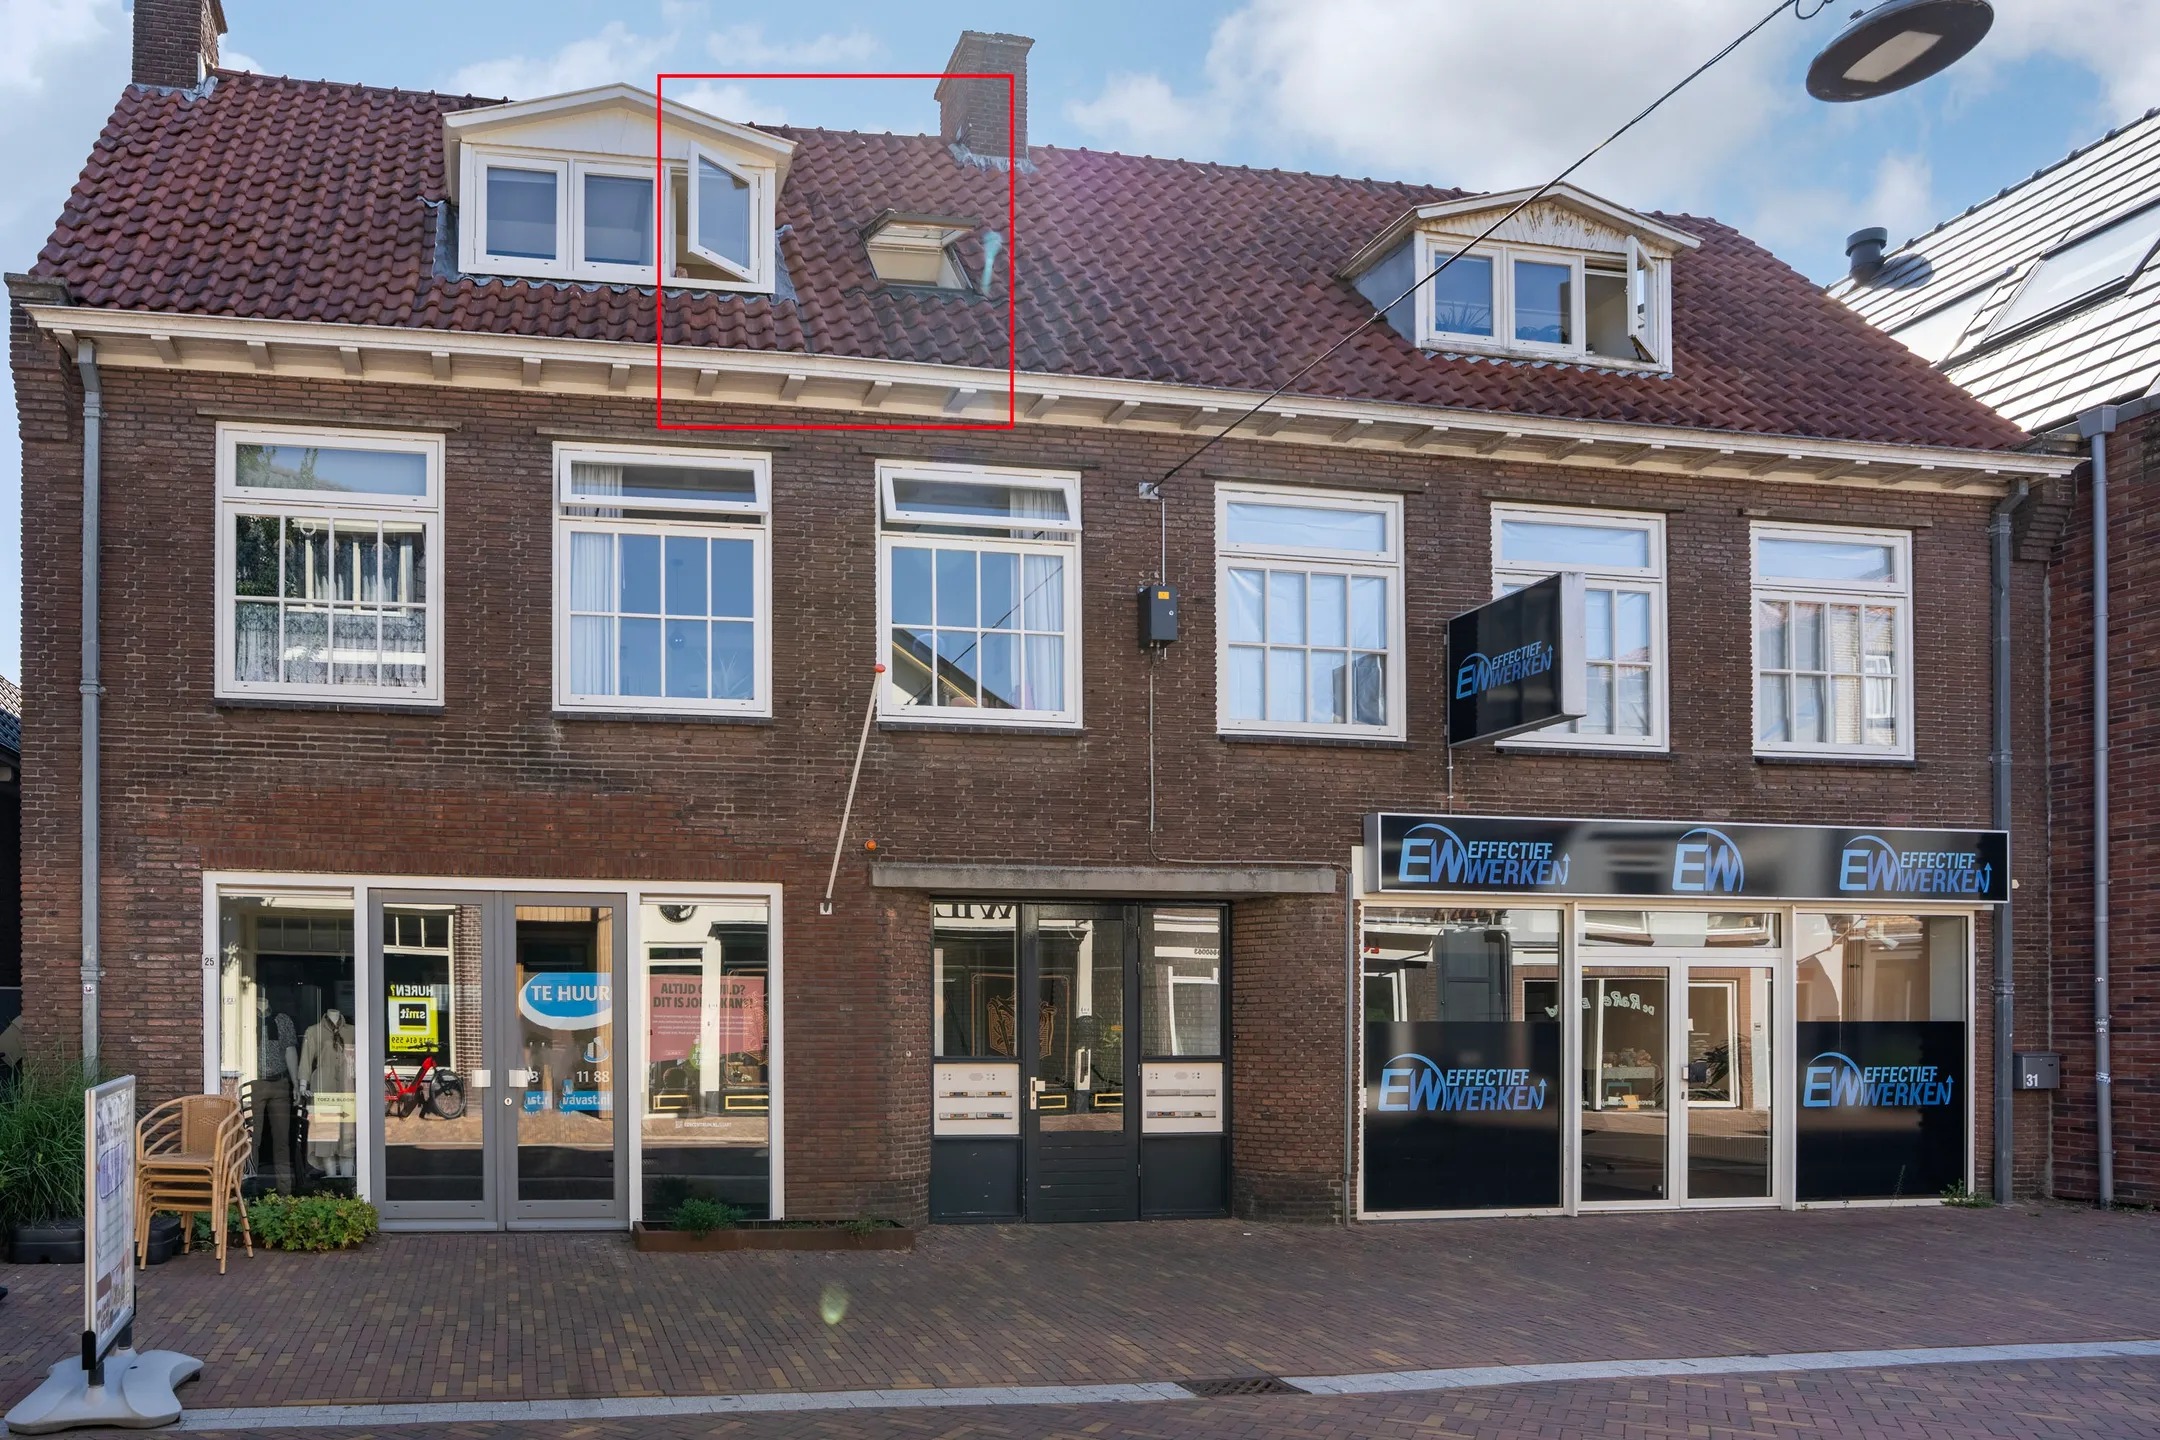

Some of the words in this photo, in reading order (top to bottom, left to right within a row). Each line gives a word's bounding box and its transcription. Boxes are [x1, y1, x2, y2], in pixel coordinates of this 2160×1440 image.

[1492, 641, 1542, 670] EFFECTIEF
[1456, 660, 1491, 699] EW
[1491, 652, 1551, 688] WERKEN
[1399, 838, 1464, 883] EW
[1468, 840, 1553, 860] EFFECTIEF
[1901, 851, 1976, 869] EFFECTIEF
[1467, 859, 1567, 885] WERKEN
[1672, 844, 1739, 892] EW
[1840, 849, 1897, 891] EW
[1901, 868, 1989, 893] WERKEN
[204, 957, 215, 966] 25
[531, 985, 552, 1001] TE
[558, 985, 611, 1002] HUUR
[661, 983, 696, 994] ALTIJD
[653, 997, 672, 1008] DIT
[674, 997, 684, 1008] IS
[577, 1071, 589, 1083] 11
[594, 1071, 610, 1083] 88
[1446, 1068, 1529, 1086] EFFECTIEF
[1803, 1066, 1857, 1107] EW
[1863, 1066, 1938, 1083] EFFECTIEF
[2026, 1074, 2039, 1087] 31
[1378, 1068, 1442, 1111] EW
[1446, 1086, 1544, 1111] WERKEN
[1862, 1082, 1950, 1106] WERKEN
